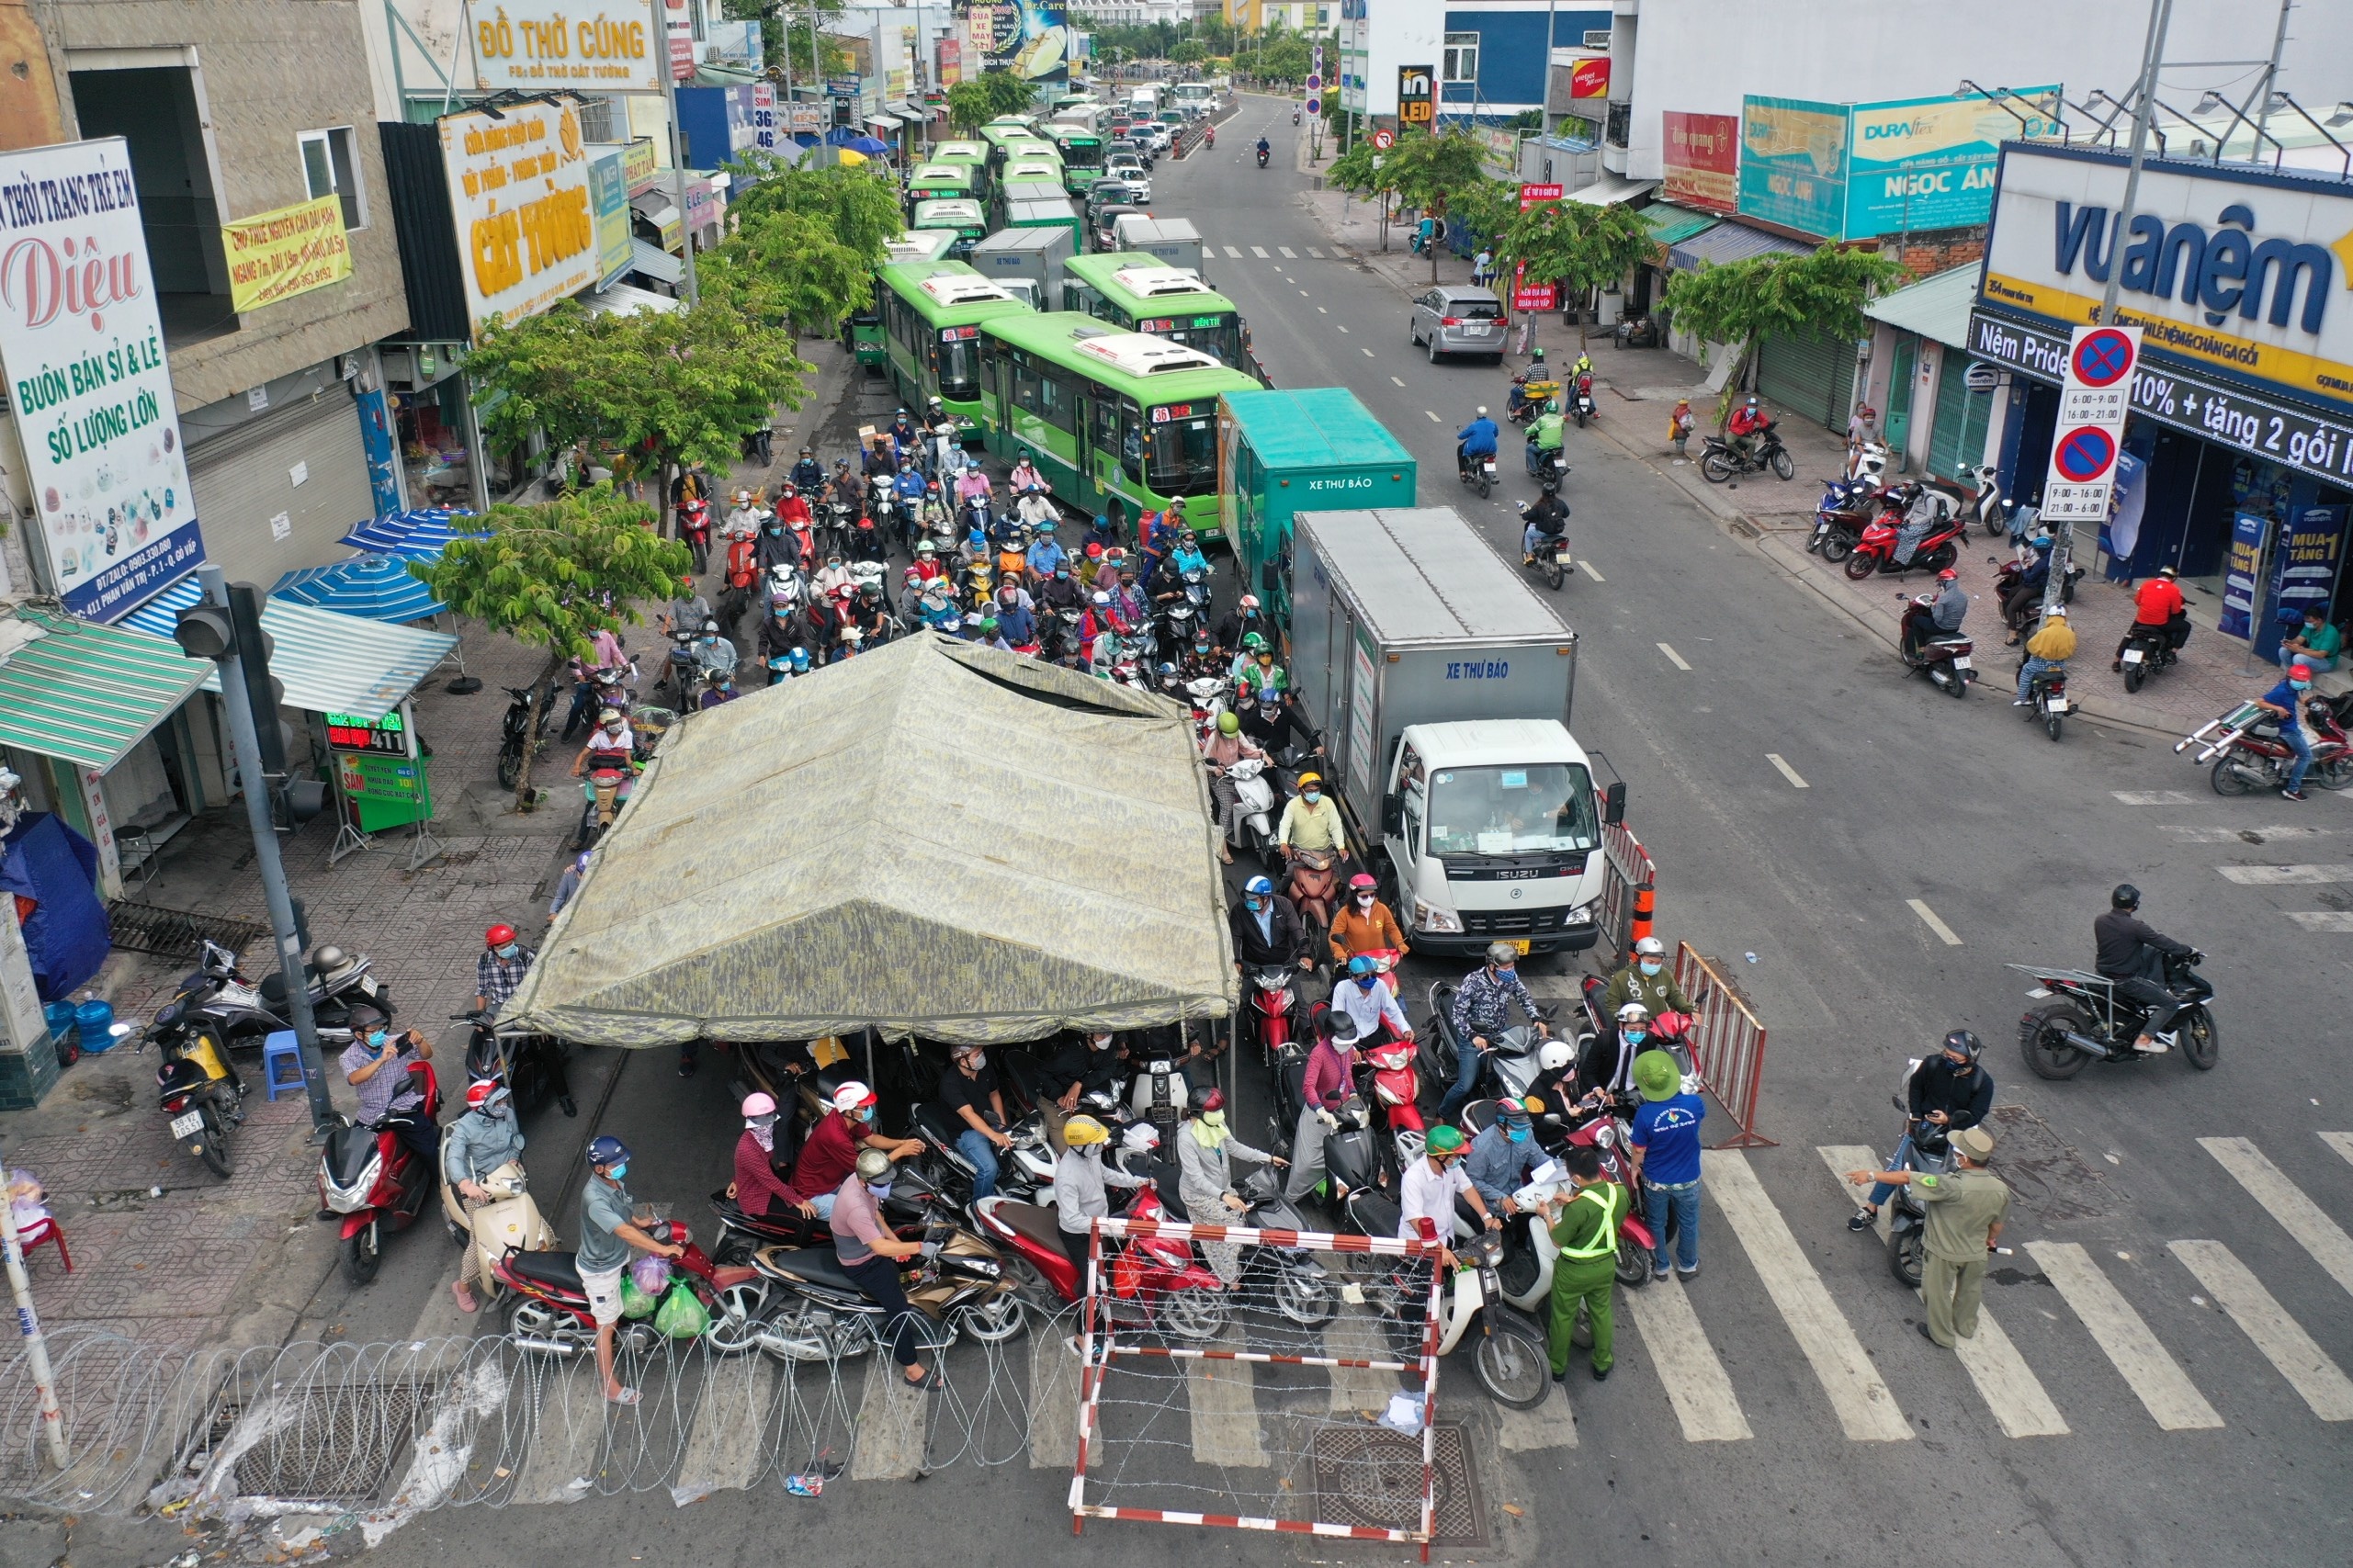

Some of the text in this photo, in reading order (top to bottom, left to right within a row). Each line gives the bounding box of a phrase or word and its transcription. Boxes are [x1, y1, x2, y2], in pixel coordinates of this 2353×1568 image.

[478, 6, 645, 59] ĐỒ THỜ CÚNG
[755, 97, 771, 107] SIM
[1400, 103, 1431, 121] LED
[755, 111, 773, 128] 3G
[756, 131, 774, 148] 4G
[4, 170, 43, 229] THỜI
[40, 175, 89, 222] TRANG
[87, 153, 116, 213] TRẺ
[113, 168, 135, 209] EM
[1884, 164, 1997, 199] NGỌC ÁN
[232, 231, 248, 252] CHO
[268, 213, 296, 242] NGUYÊN
[471, 198, 524, 297] CÁT
[519, 178, 592, 276] TƯỜNG
[232, 261, 258, 285] NGANG
[1, 236, 143, 333] Diệu
[1987, 279, 2002, 293] 354
[2087, 305, 2101, 325] HỆ
[1143, 321, 1152, 331] 36
[1979, 322, 2018, 361] Nệm
[17, 325, 162, 415] BUÔN BÁN SỈ & LẺ
[1156, 408, 1167, 422] 36
[2132, 372, 2175, 415] 10%
[2265, 417, 2284, 451] 2
[48, 387, 159, 465] SỐ LƯỢNG LỚN
[1309, 476, 1372, 491] XE THƯ BÁO
[2053, 488, 2103, 499] 9:00 16:00
[2051, 503, 2100, 513] 21:00 6:00
[2233, 541, 2250, 558] MUA
[2290, 547, 2324, 563] TẶNG
[2291, 533, 2338, 560] MUA 1
[2230, 556, 2249, 572] TẶNG
[86, 598, 101, 617] 411
[101, 589, 121, 607] PHAN
[120, 577, 135, 597] VĂN
[1446, 658, 1508, 679] XE THƯ BÁO
[371, 729, 403, 750] 411
[344, 771, 365, 791] SÂM
[1496, 870, 1539, 879] ISUZU
